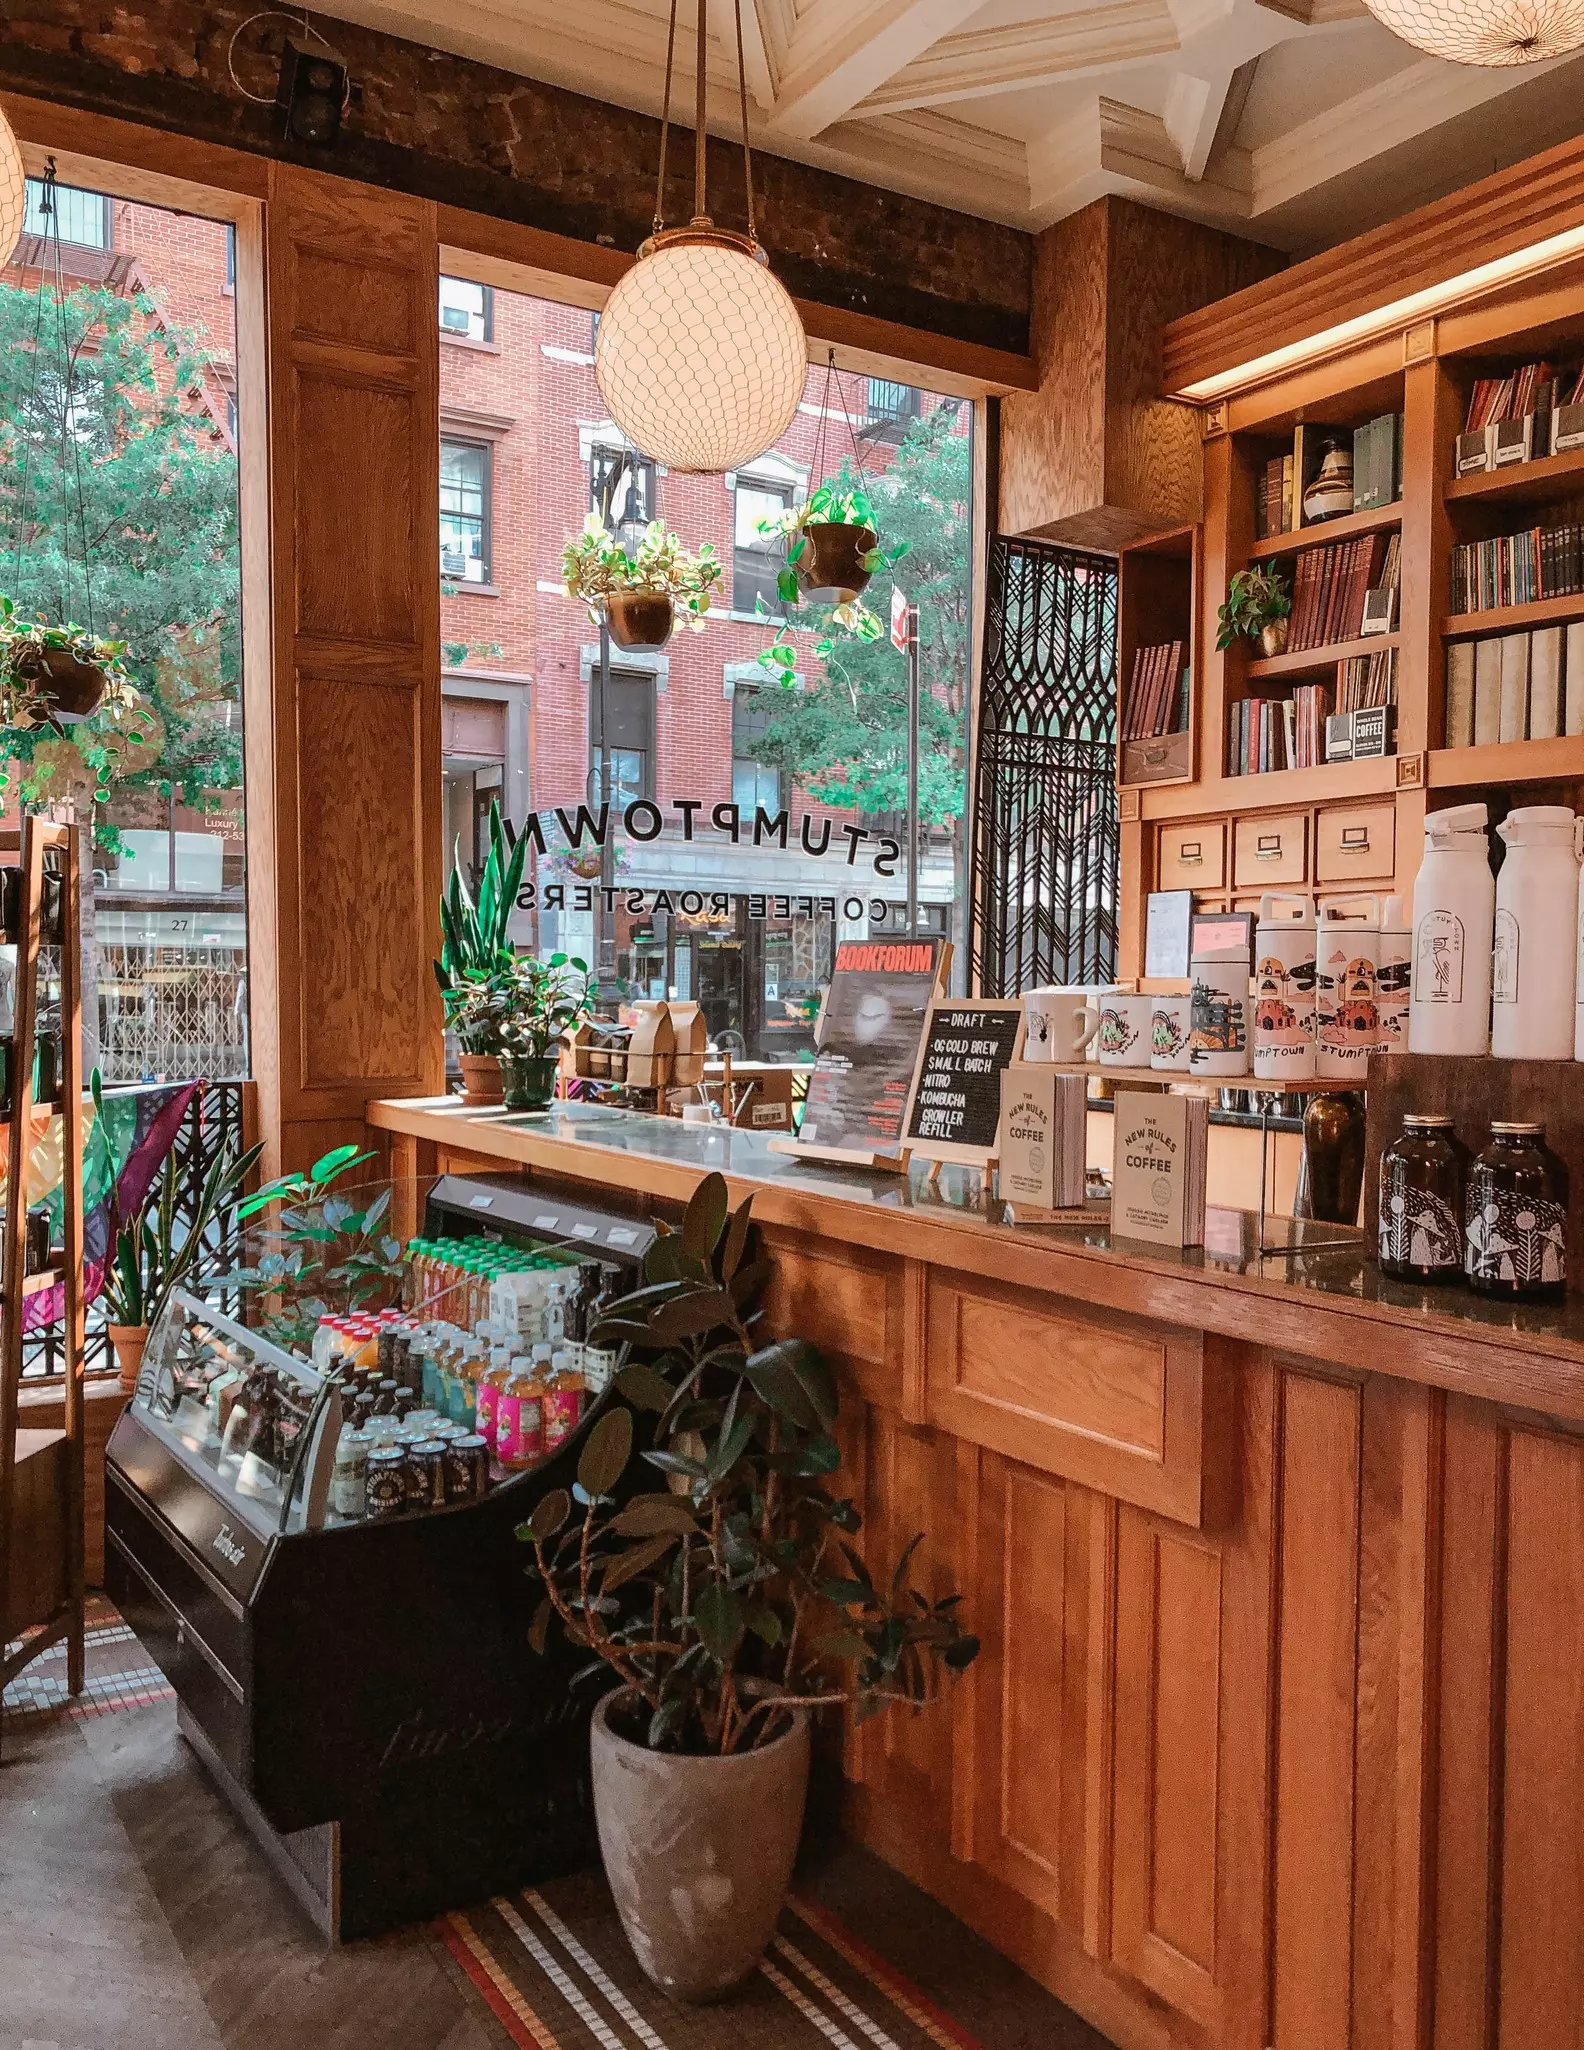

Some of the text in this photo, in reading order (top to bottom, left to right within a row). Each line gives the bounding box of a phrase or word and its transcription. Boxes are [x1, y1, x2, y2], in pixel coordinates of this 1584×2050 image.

[1356, 721, 1383, 738] COFFEE
[204, 817, 239, 831] Luxury
[171, 919, 188, 932] 27
[835, 944, 933, 972] BOOKFORUM
[767, 988, 775, 996] A
[950, 1013, 986, 1029] DRAFT
[946, 1039, 969, 1055] COLD
[970, 1040, 999, 1057] BREW
[928, 1056, 993, 1074] SMALL BATCH
[924, 1073, 951, 1089] NITRO
[920, 1090, 966, 1108] KOMBUCHA
[1023, 1092, 1033, 1100] THE
[922, 1108, 964, 1127] GROWLER
[1008, 1102, 1048, 1125] NEW RULES
[1144, 1117, 1157, 1126] THE
[918, 1121, 953, 1138] REFILL
[1009, 1126, 1045, 1143] COFFEE
[1124, 1128, 1177, 1154] NEW RULES
[1144, 1141, 1154, 1155] of
[1125, 1154, 1172, 1173] COFFEE
